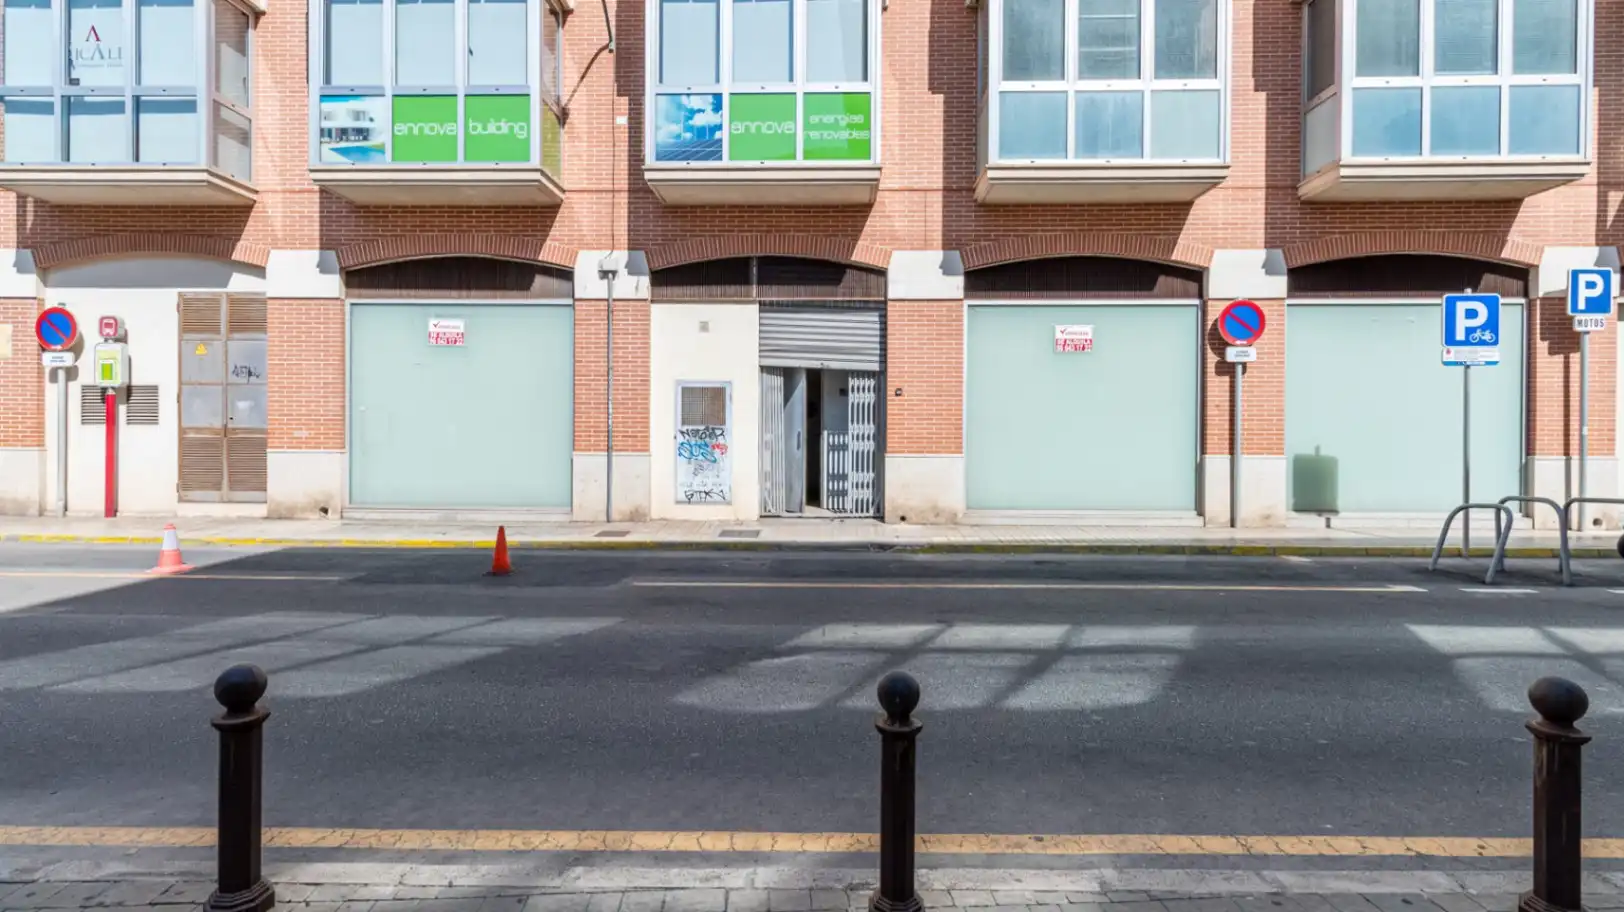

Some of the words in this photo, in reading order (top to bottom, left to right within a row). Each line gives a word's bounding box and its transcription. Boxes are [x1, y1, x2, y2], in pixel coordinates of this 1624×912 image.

[394, 121, 457, 136] ennova
[469, 117, 528, 139] building
[731, 121, 796, 134] ennova
[803, 128, 870, 140] renovables
[1577, 272, 1605, 310] P
[1455, 300, 1489, 341] P
[1576, 318, 1605, 328] MOTOS
